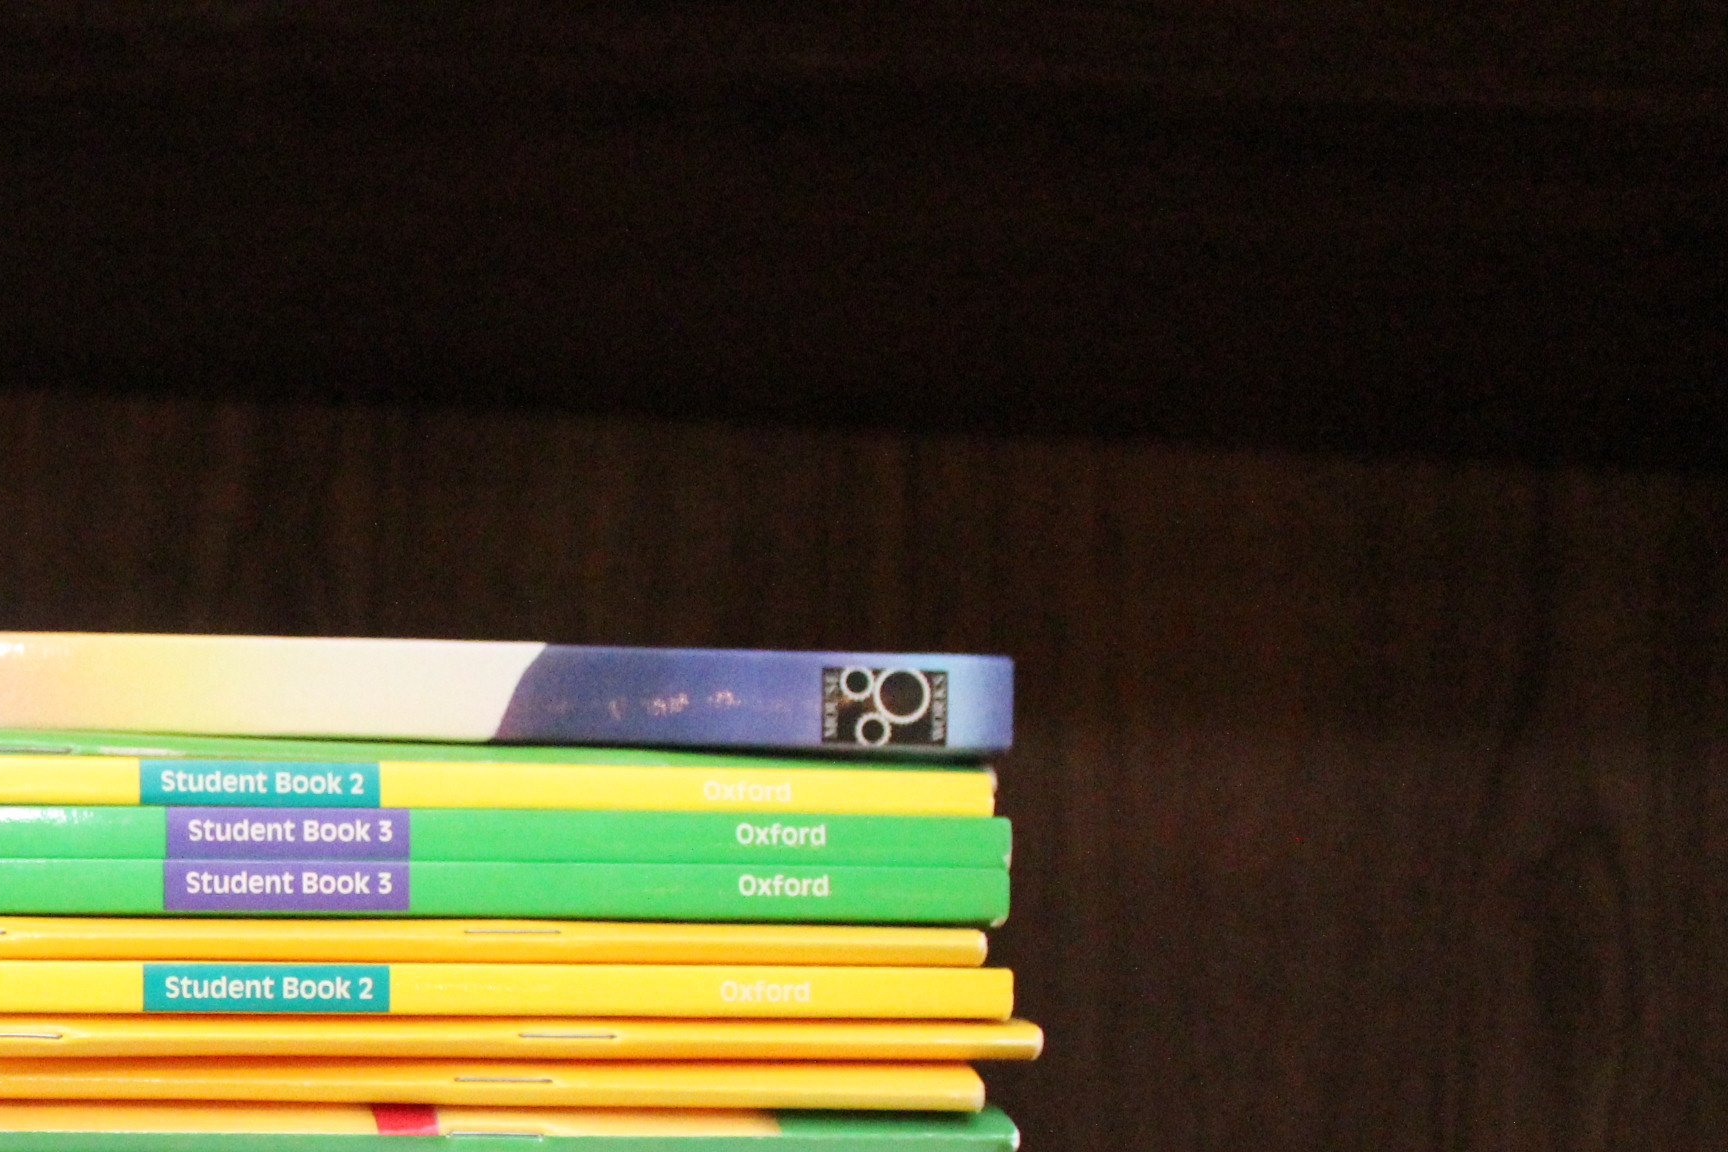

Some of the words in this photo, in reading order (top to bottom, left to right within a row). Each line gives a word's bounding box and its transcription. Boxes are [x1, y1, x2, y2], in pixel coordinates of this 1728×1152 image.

[160, 769, 268, 794] Student
[275, 771, 343, 795] Book
[349, 772, 364, 795] 2
[703, 780, 792, 803] Oxford
[188, 818, 296, 843] Student
[302, 819, 372, 843] Book
[378, 820, 393, 842] 3
[736, 823, 827, 846] Oxford
[186, 871, 294, 896] Student
[301, 872, 371, 896] Book
[378, 872, 393, 895] 3
[738, 874, 830, 897] Oxford
[164, 976, 275, 1000] Student
[281, 976, 351, 1001] Book
[358, 977, 373, 1000] 2
[720, 980, 811, 1003] Oxford
